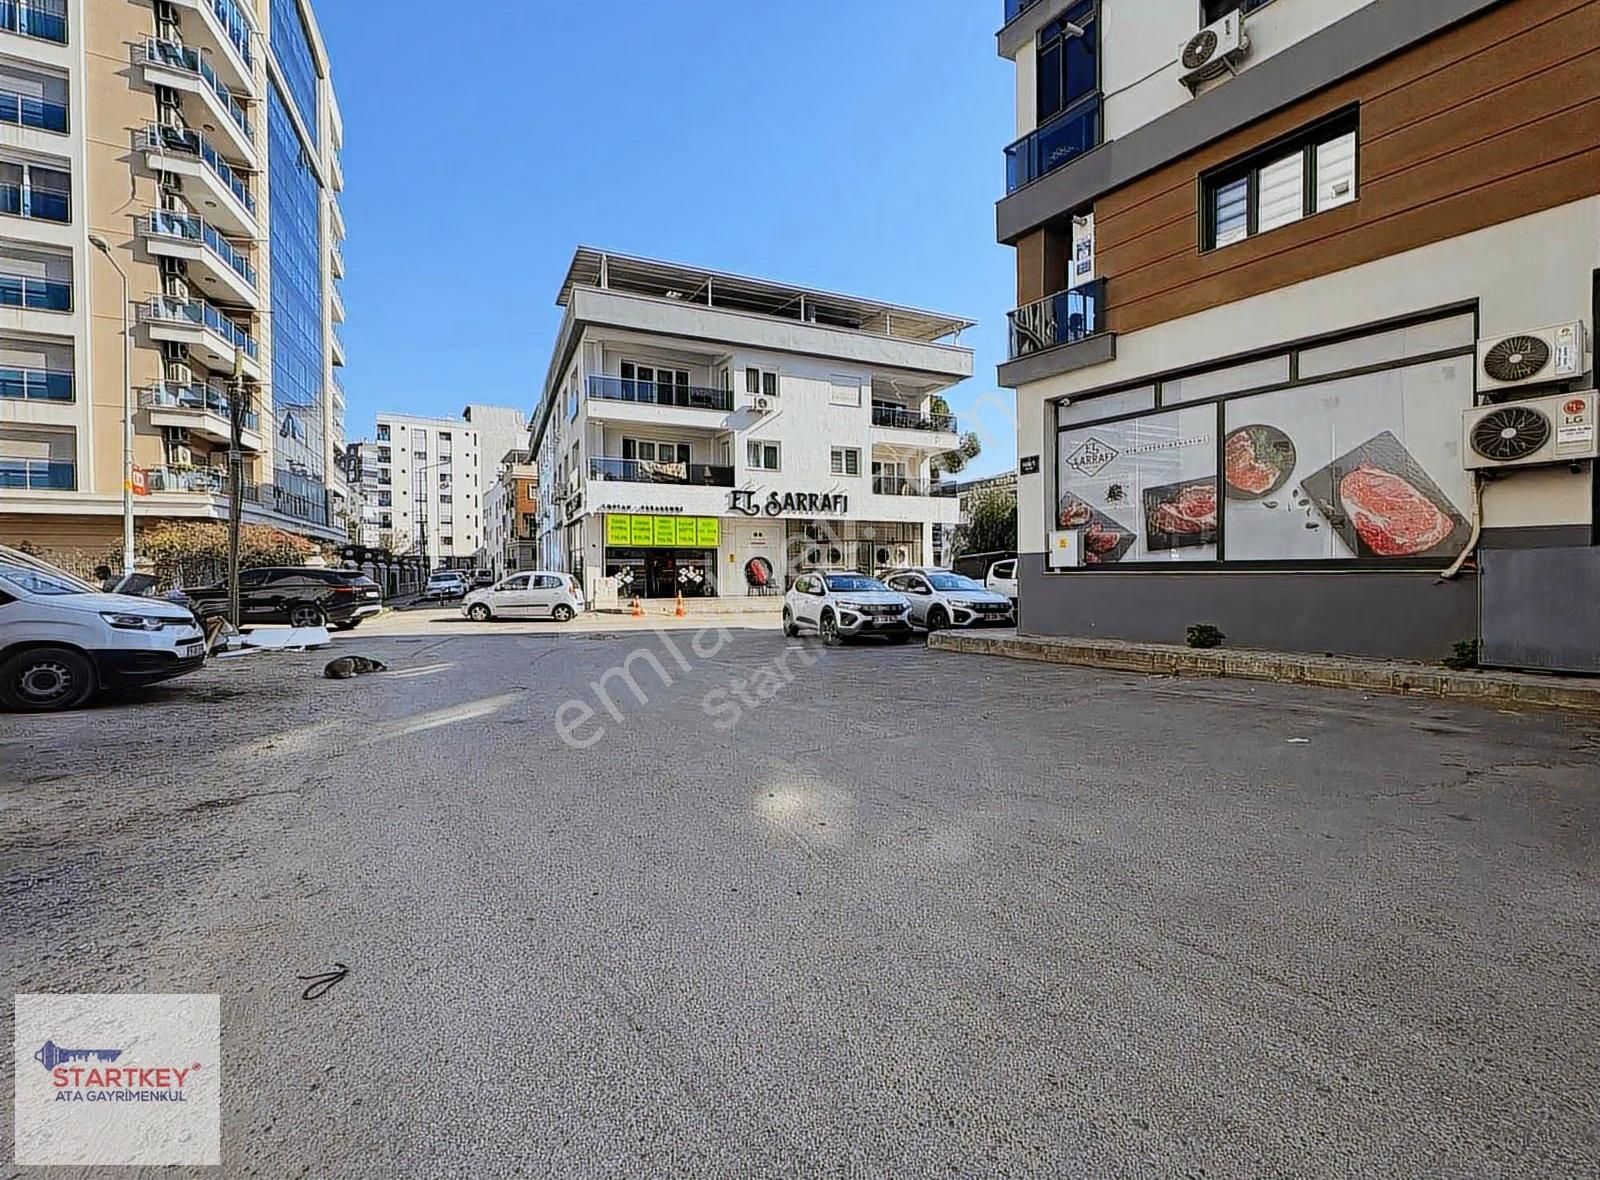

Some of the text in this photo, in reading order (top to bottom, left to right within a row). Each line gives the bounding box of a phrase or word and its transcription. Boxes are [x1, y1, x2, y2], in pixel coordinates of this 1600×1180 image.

[1565, 415, 1584, 425] LG
[1073, 451, 1115, 466] SARRAFI
[728, 490, 848, 517] ET SARRAFI
